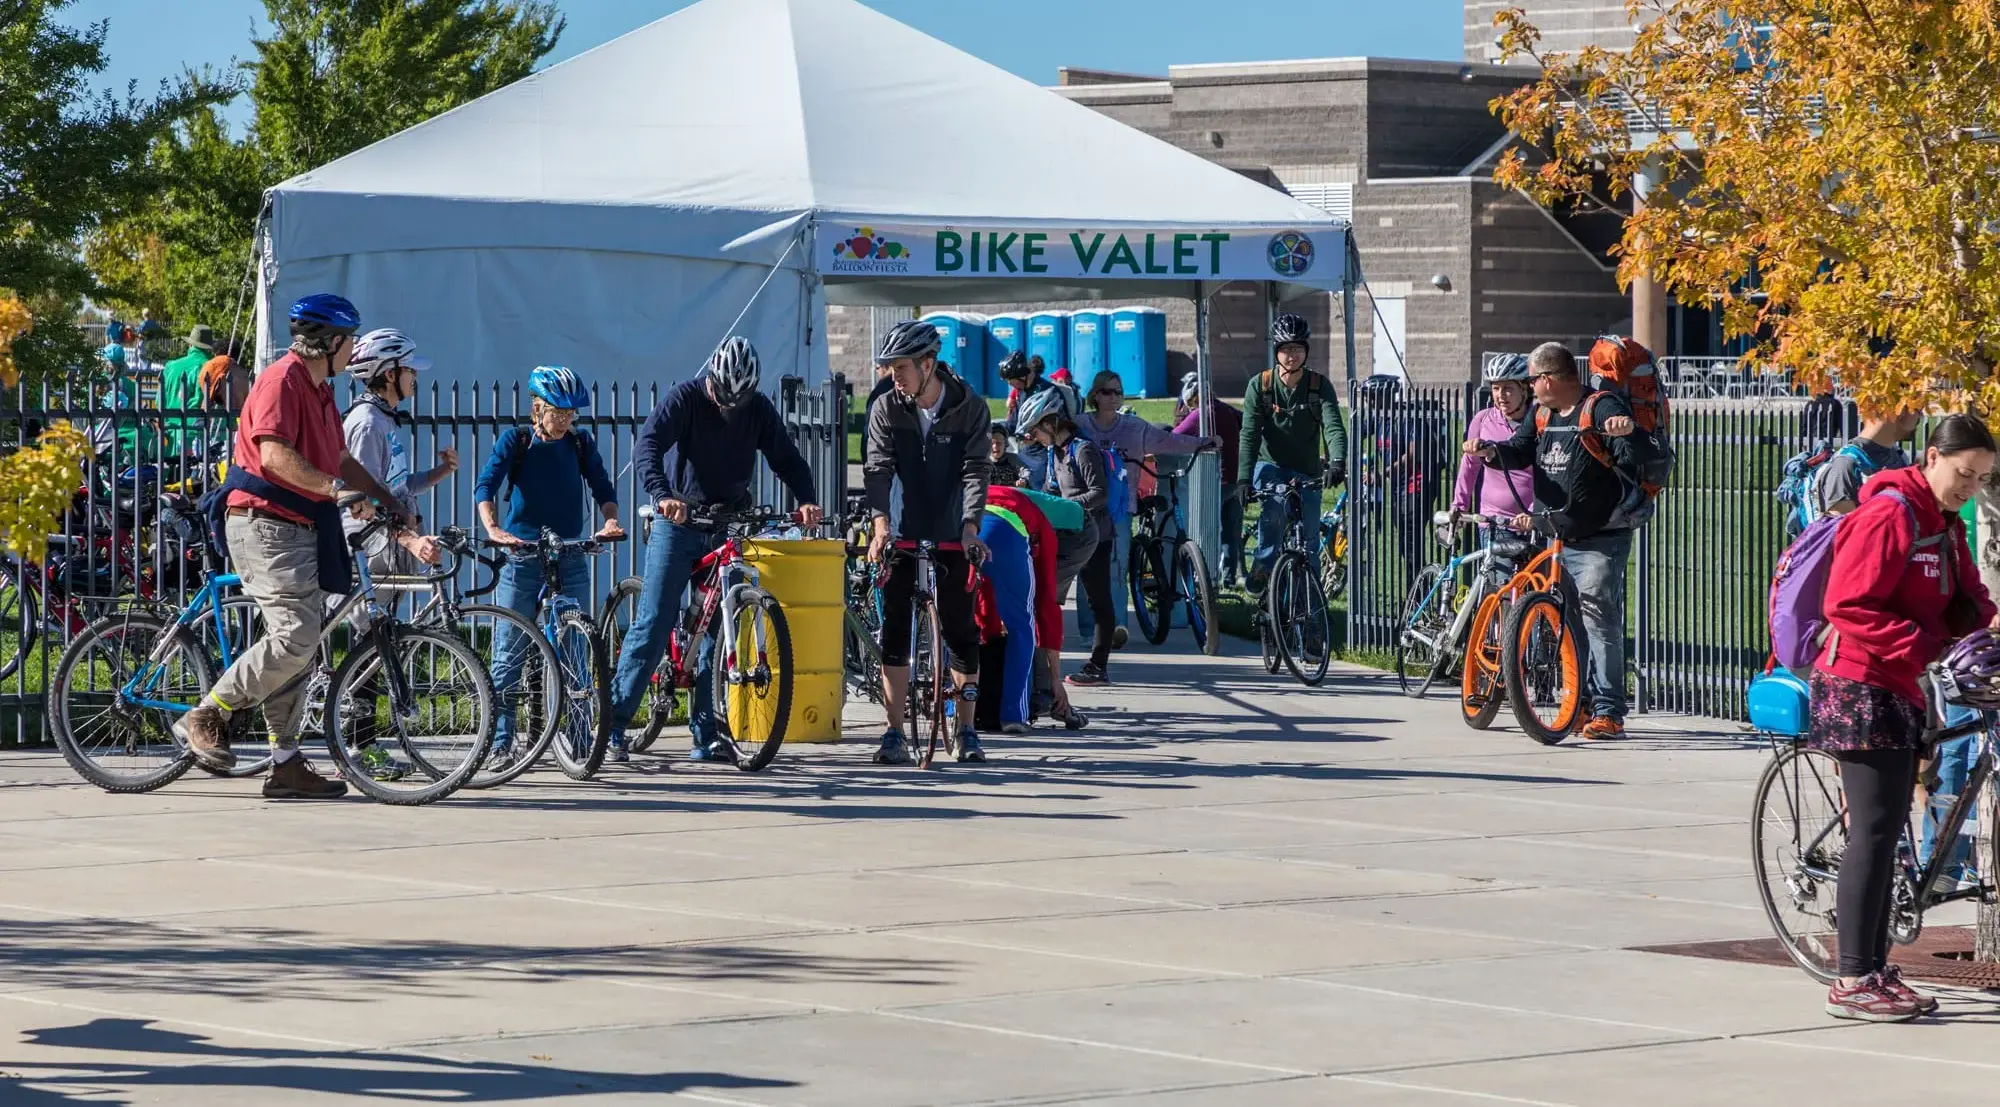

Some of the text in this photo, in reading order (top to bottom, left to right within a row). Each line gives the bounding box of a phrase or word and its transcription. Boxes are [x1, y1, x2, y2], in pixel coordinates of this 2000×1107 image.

[935, 231, 1048, 273] BIKE
[1069, 233, 1231, 275] VALET
[832, 262, 873, 272] BALLOON
[875, 263, 909, 273] FIESTA
